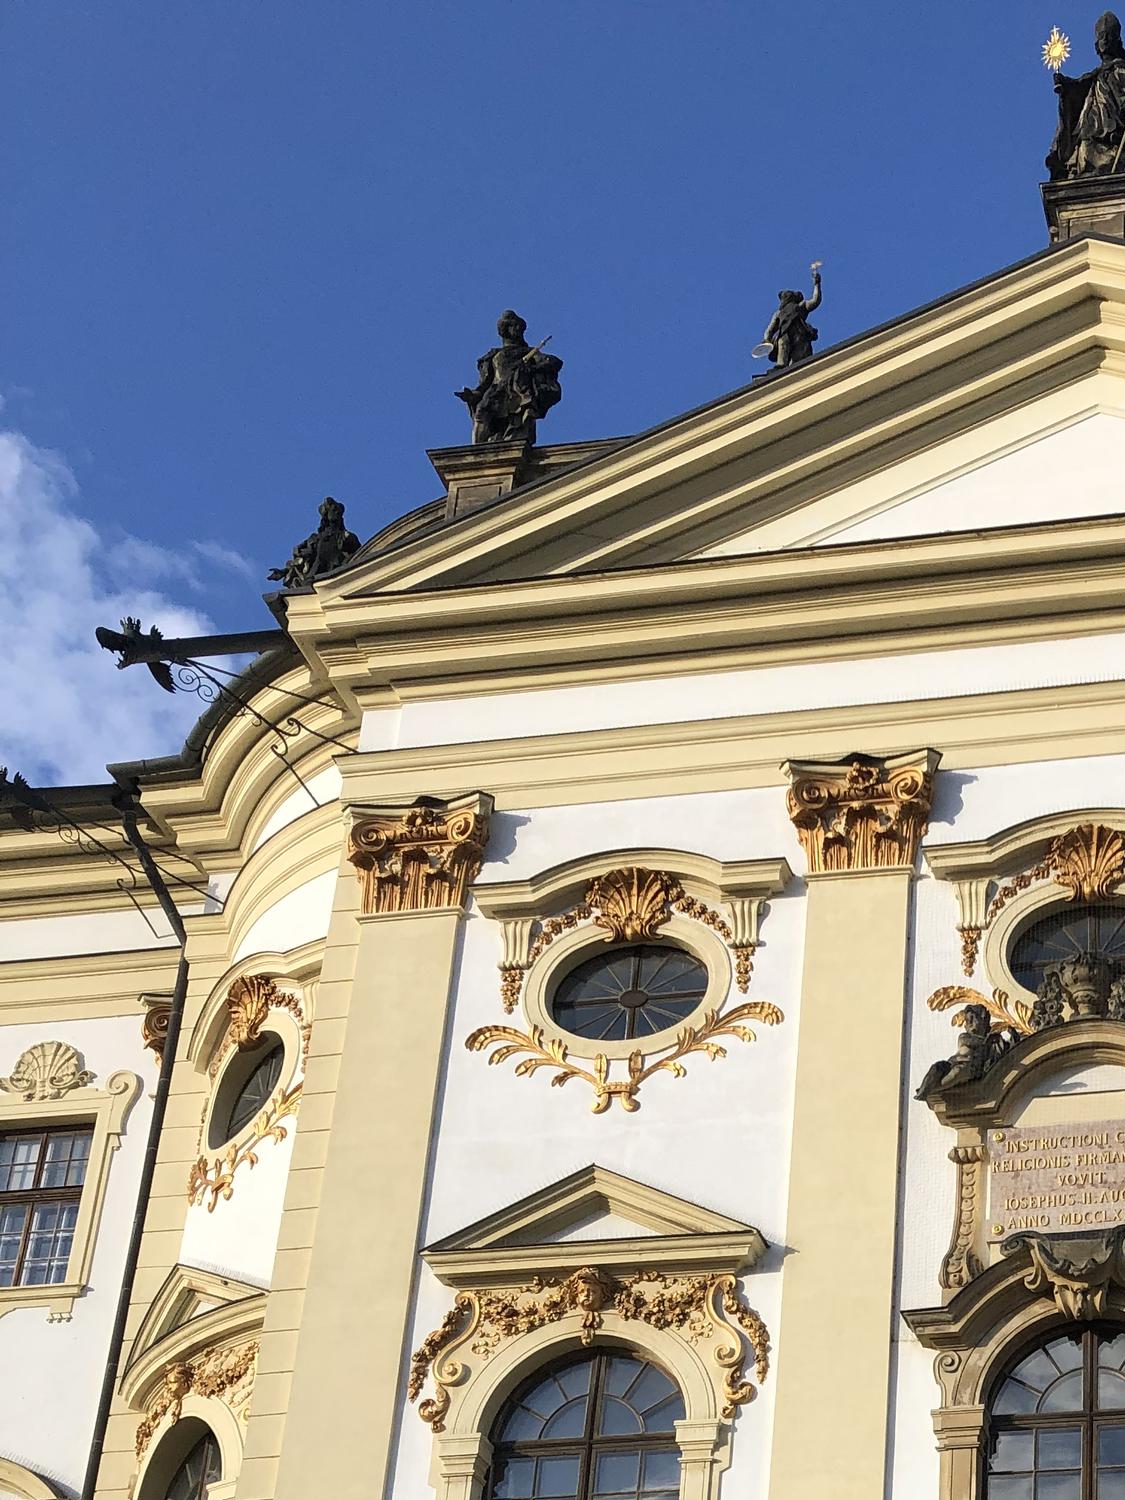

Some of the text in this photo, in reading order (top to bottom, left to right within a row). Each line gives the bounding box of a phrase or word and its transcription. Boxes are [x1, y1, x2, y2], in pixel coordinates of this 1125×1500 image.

[1005, 1132, 1109, 1153] INSTRUCTIONI
[1058, 1172, 1106, 1187] VOVIT
[1006, 1213, 1050, 1230] ANNO
